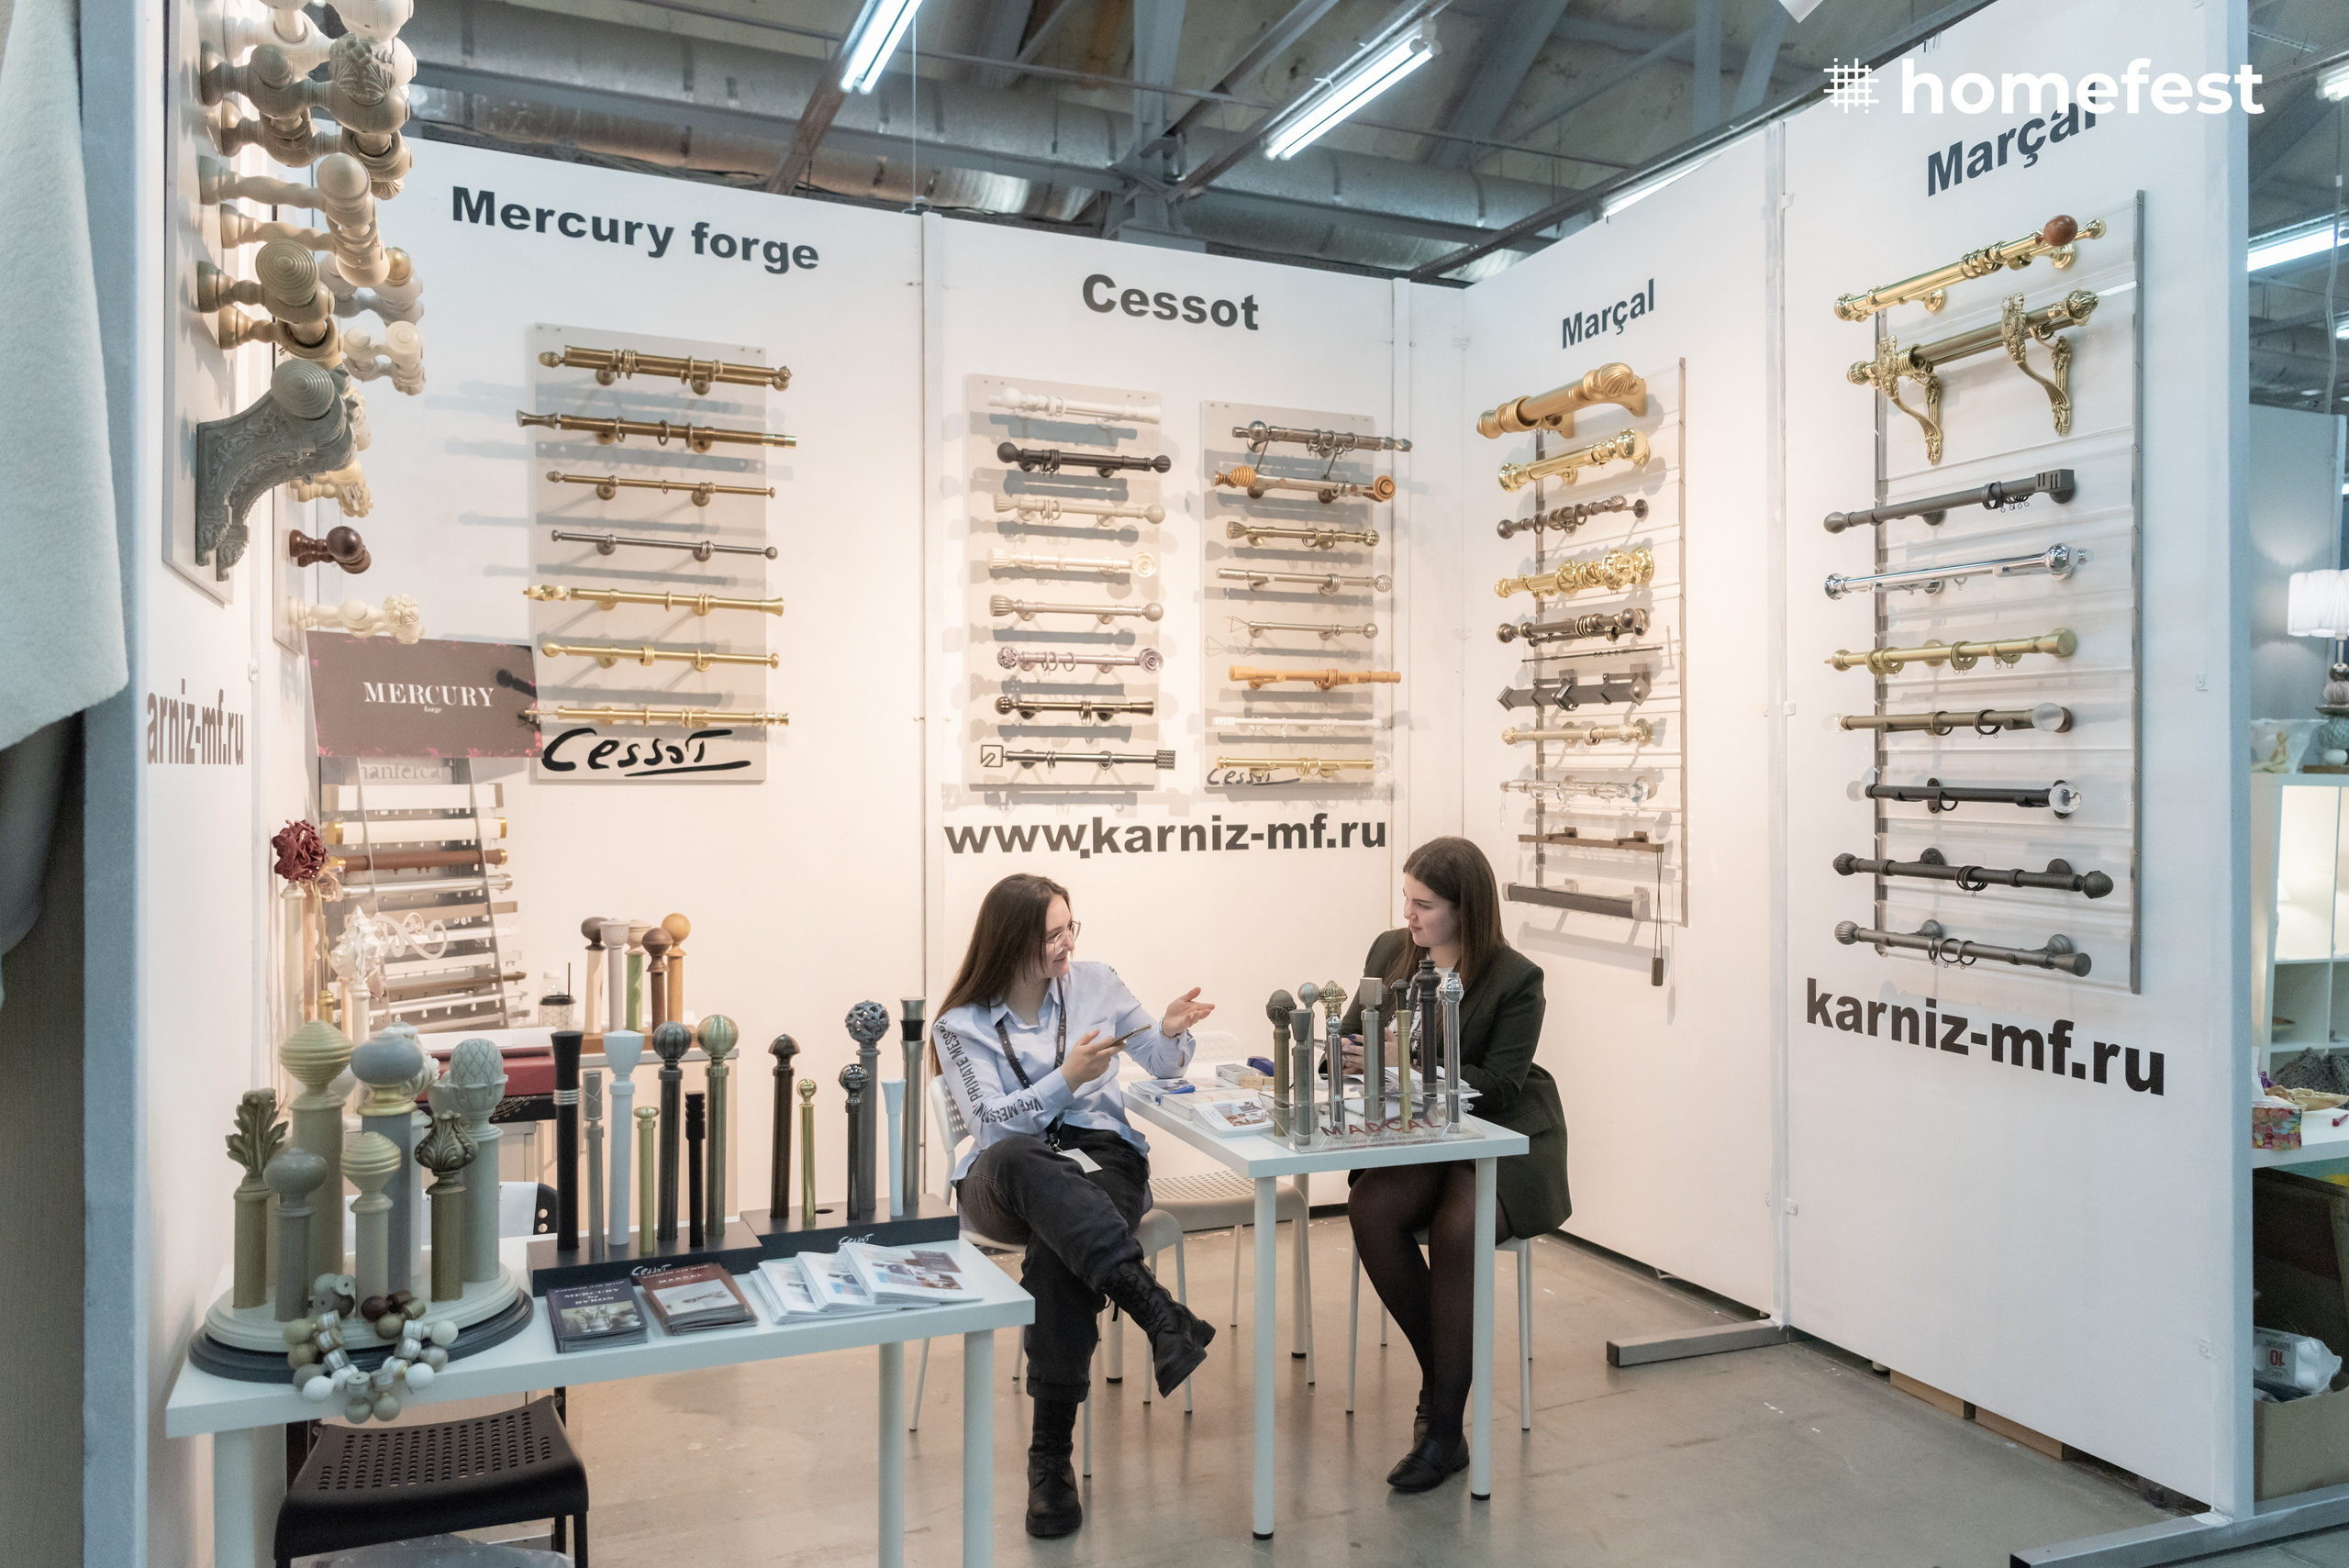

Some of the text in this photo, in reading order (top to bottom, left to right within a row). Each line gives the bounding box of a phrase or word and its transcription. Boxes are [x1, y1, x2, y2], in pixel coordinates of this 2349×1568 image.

[451, 186, 819, 275] Mercury forge
[1083, 273, 1259, 331] Cessot
[1562, 277, 1654, 350] Marçal
[362, 681, 495, 707] MERCURY
[423, 705, 442, 714] forge
[943, 813, 1386, 860] www.karniz-mf.ru
[1806, 977, 2165, 1096] karniz-mf.ru
[956, 1056, 984, 1103] PRIVATE
[564, 1287, 619, 1298] MERCURY
